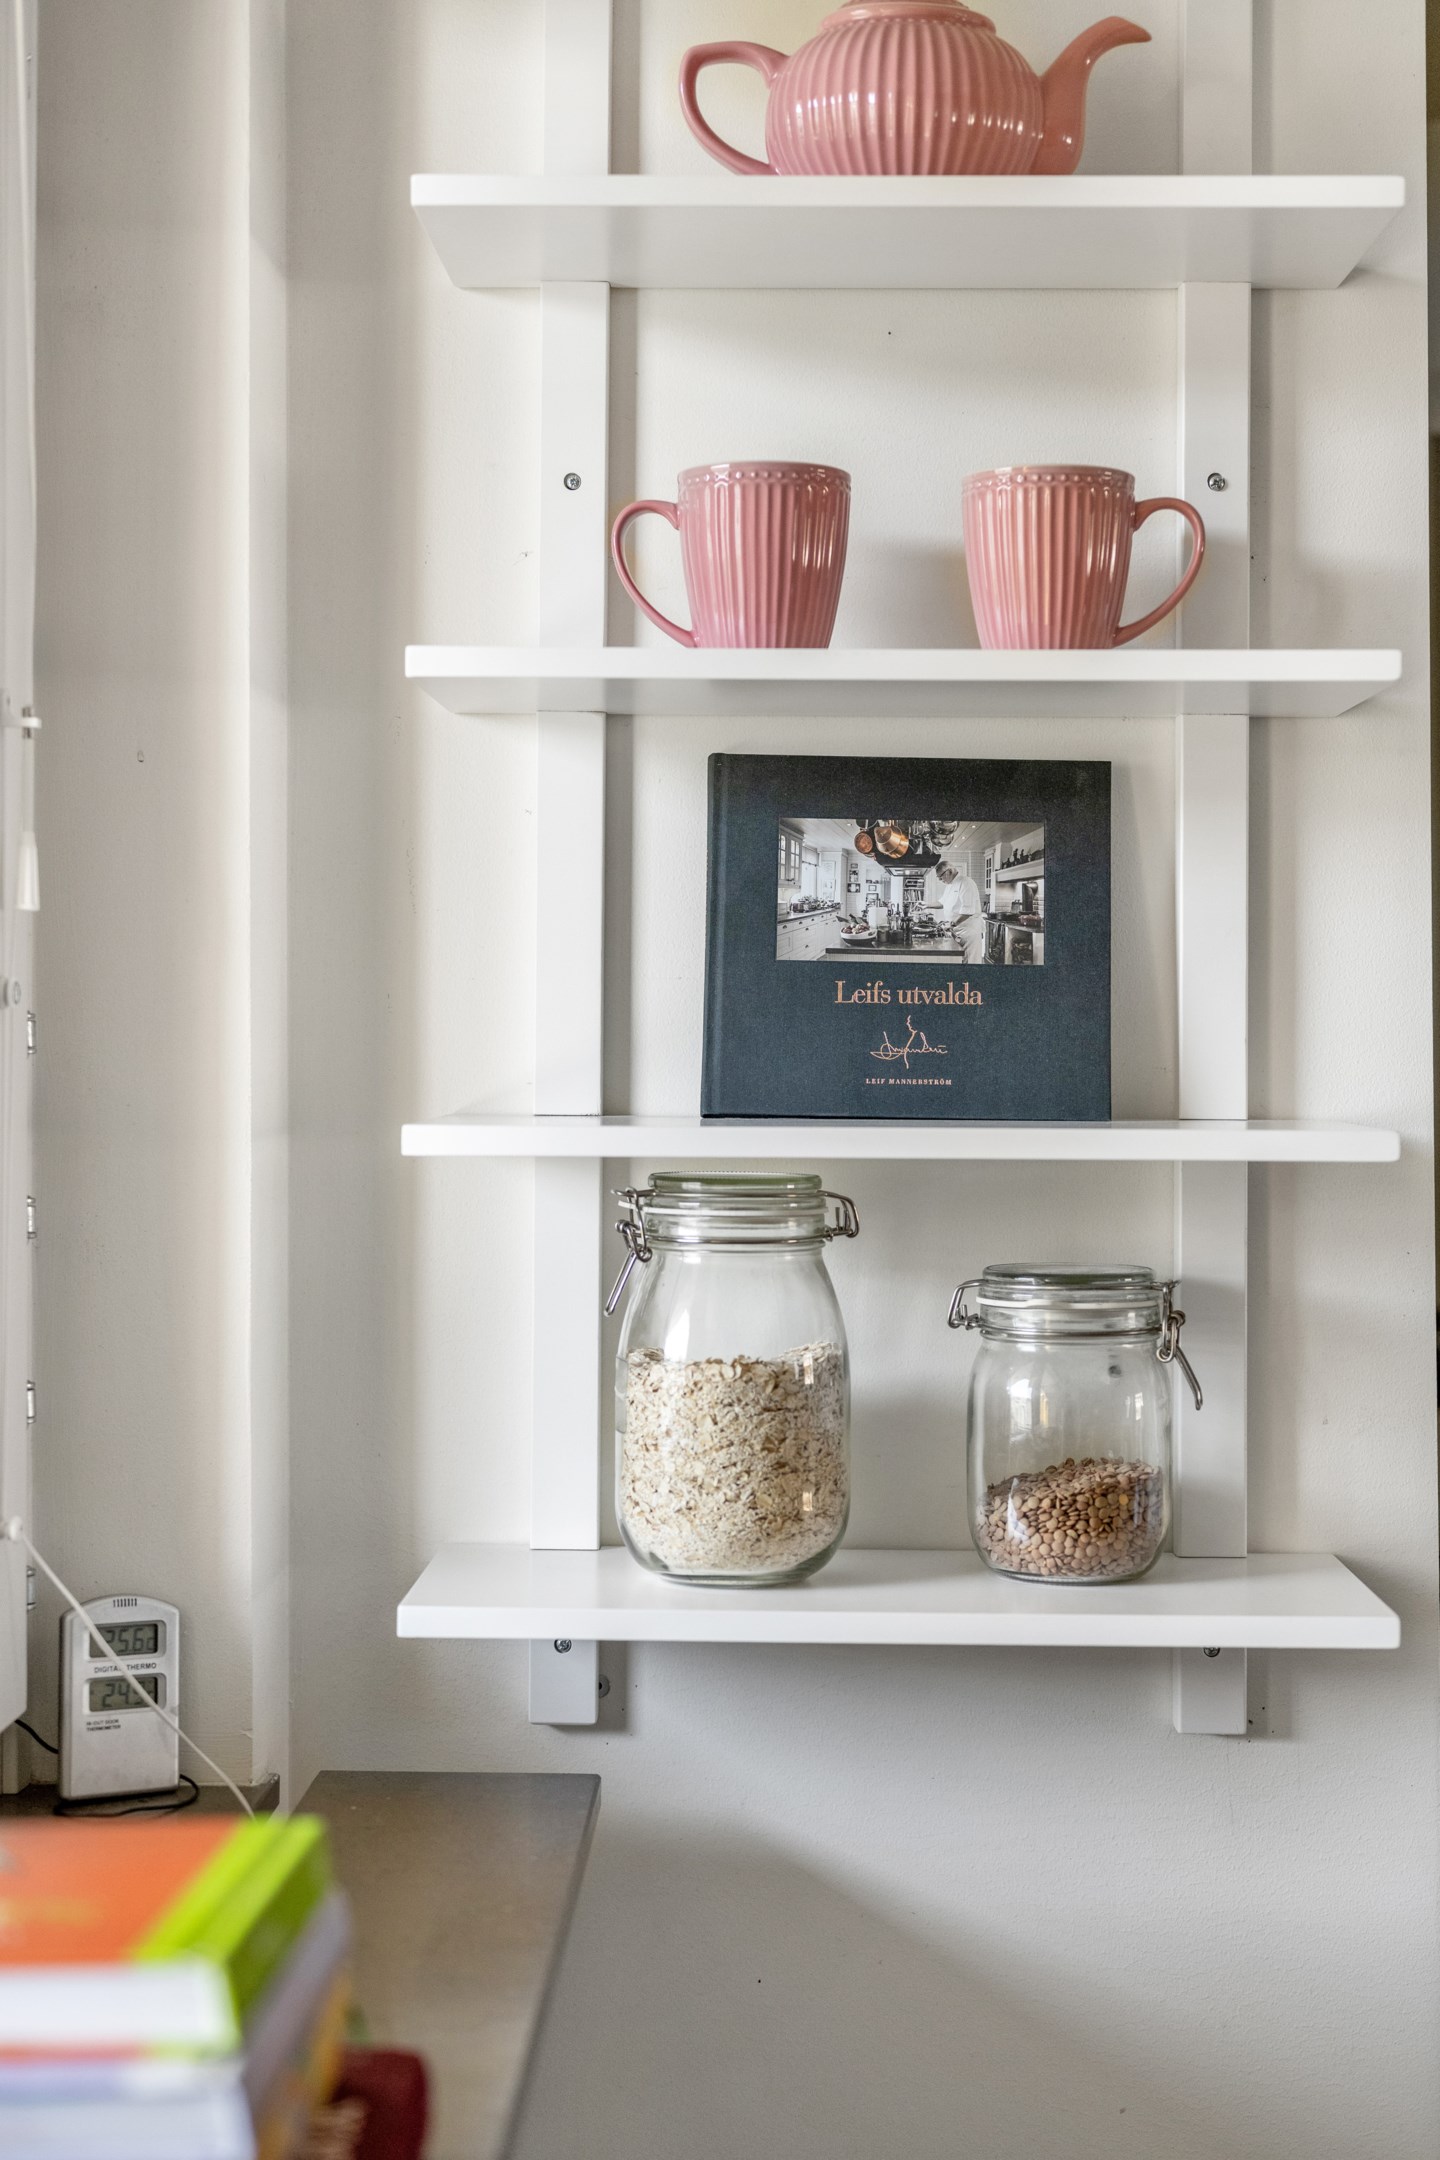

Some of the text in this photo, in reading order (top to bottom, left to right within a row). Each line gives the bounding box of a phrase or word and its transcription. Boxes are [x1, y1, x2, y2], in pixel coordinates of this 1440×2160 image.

[834, 980, 983, 1005] Leifs utvalda
[888, 1078, 952, 1086] MANNERSTRÖM
[94, 1662, 157, 1673] DIGITA THERMO
